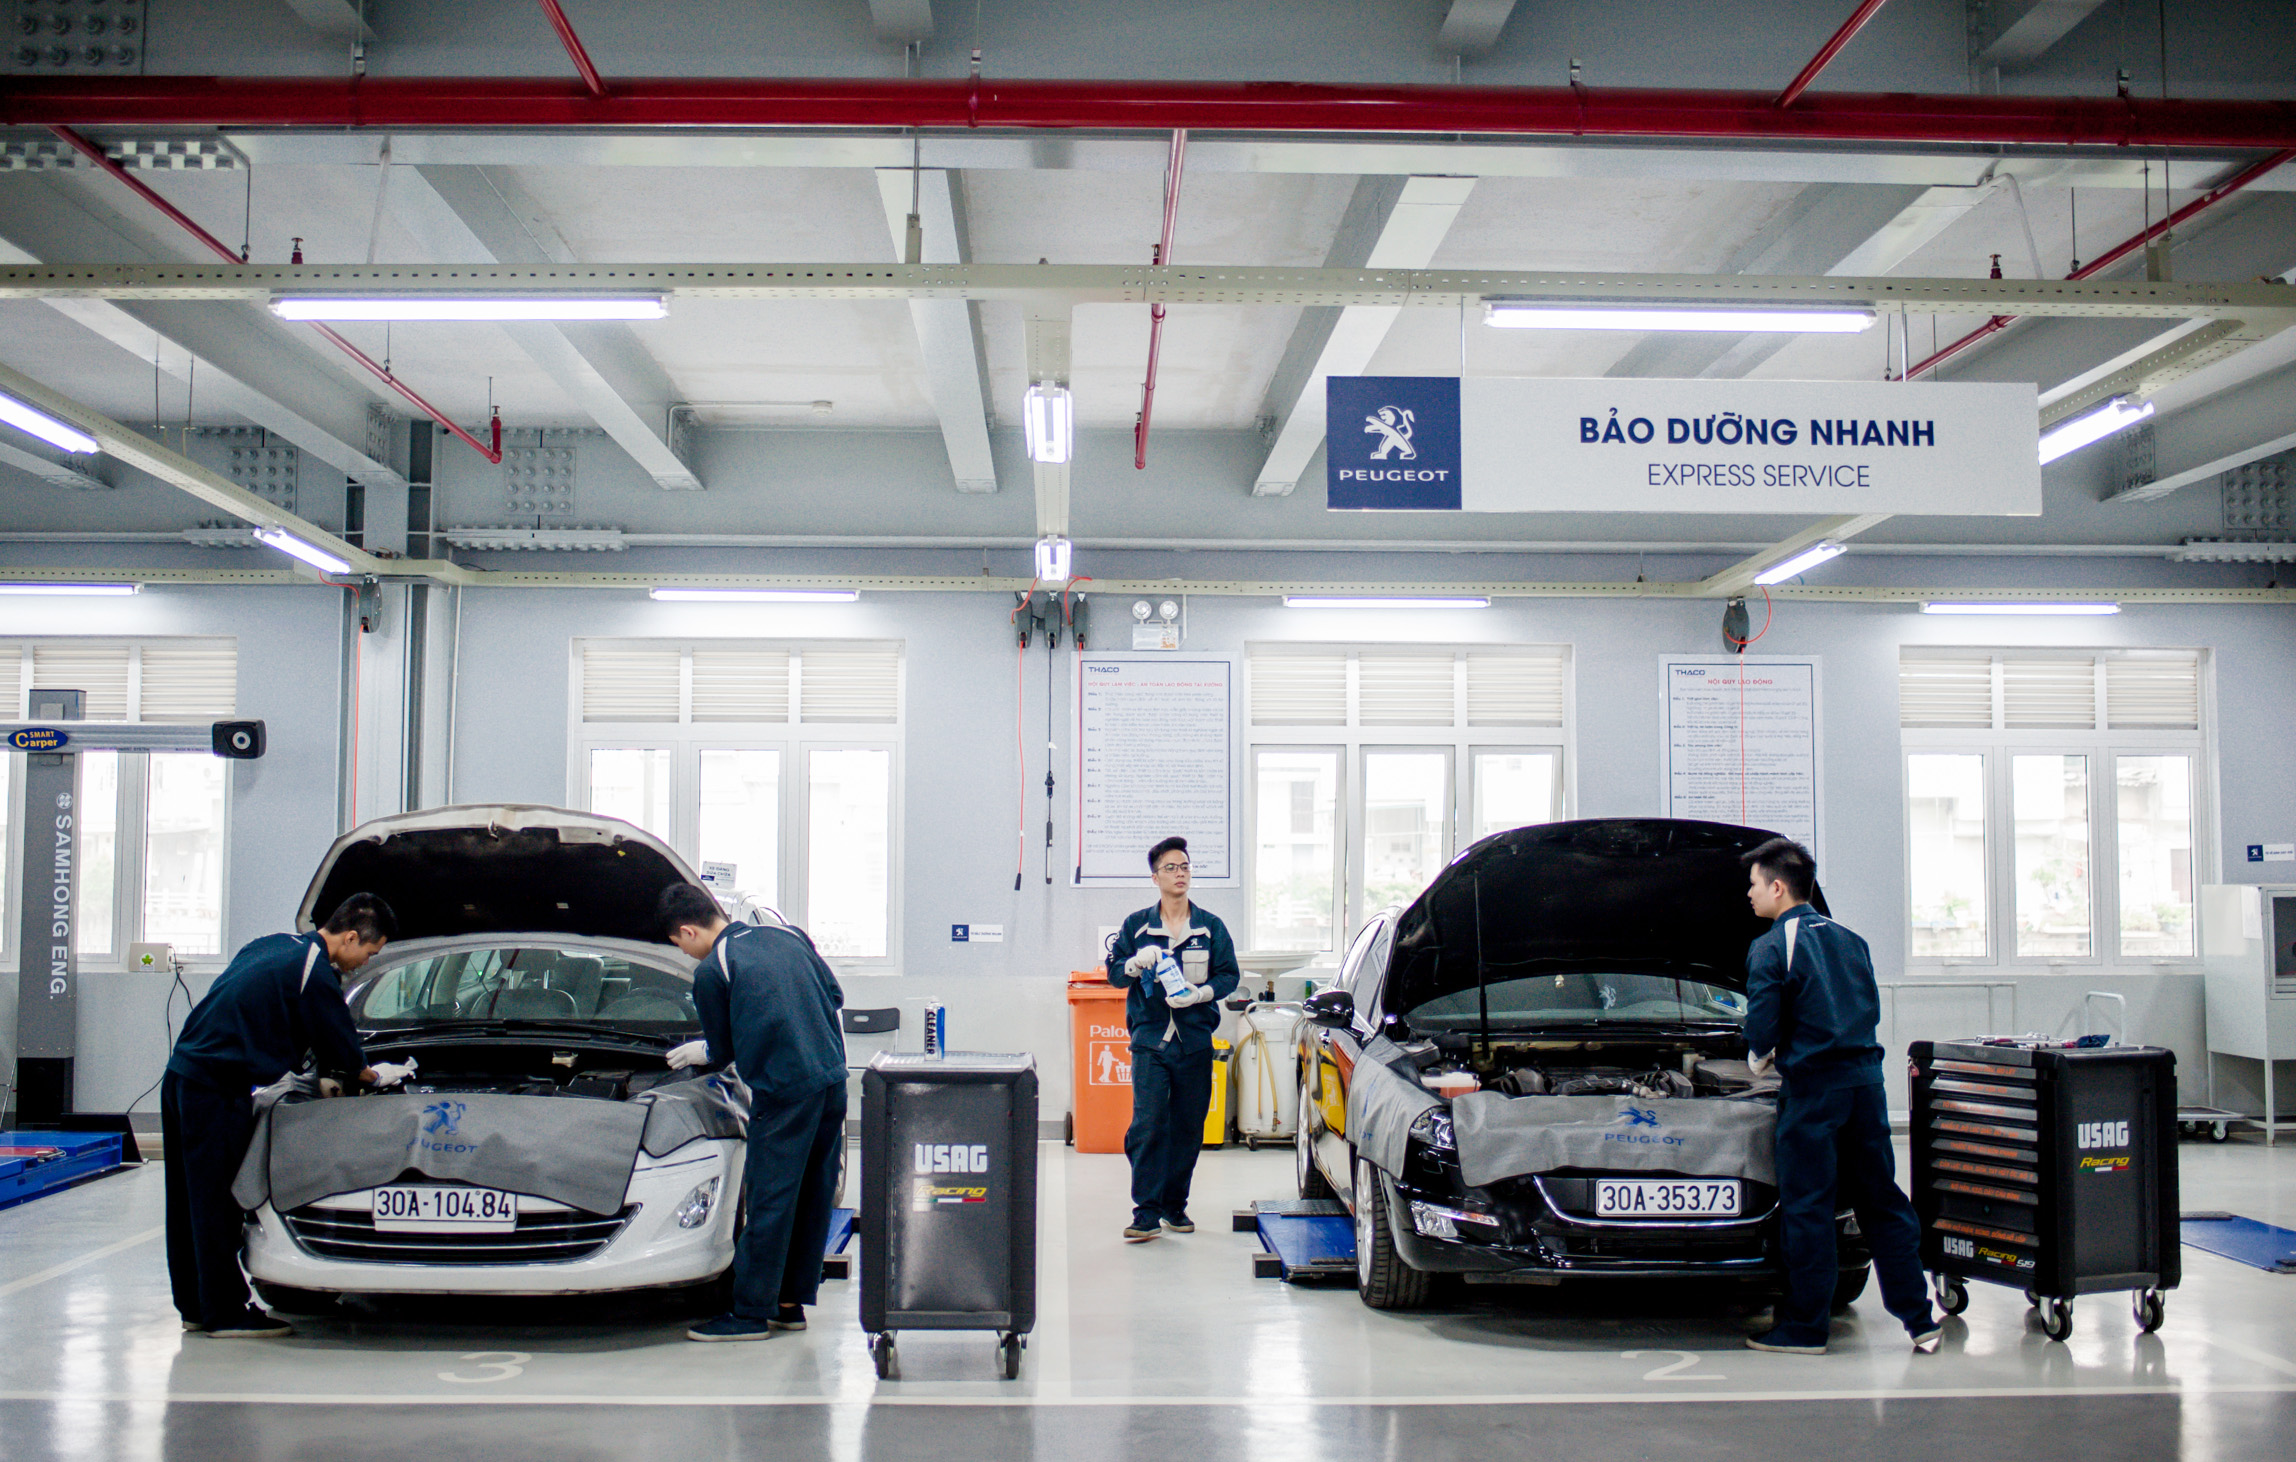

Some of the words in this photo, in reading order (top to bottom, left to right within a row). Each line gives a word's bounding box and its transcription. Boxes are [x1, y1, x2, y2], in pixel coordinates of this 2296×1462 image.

[1579, 407, 1655, 445] BẢO
[1667, 411, 1798, 446] DƯỠNG
[1810, 419, 1935, 447] NHANH
[1339, 469, 1449, 482] PEUGEOT
[1648, 463, 1756, 487] EXPRESS
[1763, 464, 1871, 488] SERVICE
[1088, 666, 1120, 674] THACO
[29, 730, 55, 739] SMART
[53, 814, 73, 938] SAMHONG
[50, 945, 68, 1000] ENG.
[926, 1011, 936, 1055] CLEANER
[1604, 1132, 1685, 1147] PEUGEOT
[2078, 1120, 2129, 1149] USAG
[914, 1144, 988, 1175] USAG
[2079, 1156, 2130, 1168] Racing
[377, 1190, 511, 1218] 30A-104.84
[915, 1184, 987, 1197] Racing
[1602, 1184, 1736, 1213] 30A-353.73
[1943, 1235, 1974, 1258] USAG
[1978, 1247, 2017, 1263] Racing
[437, 1351, 532, 1383] 3
[1620, 1350, 1728, 1380] 2
